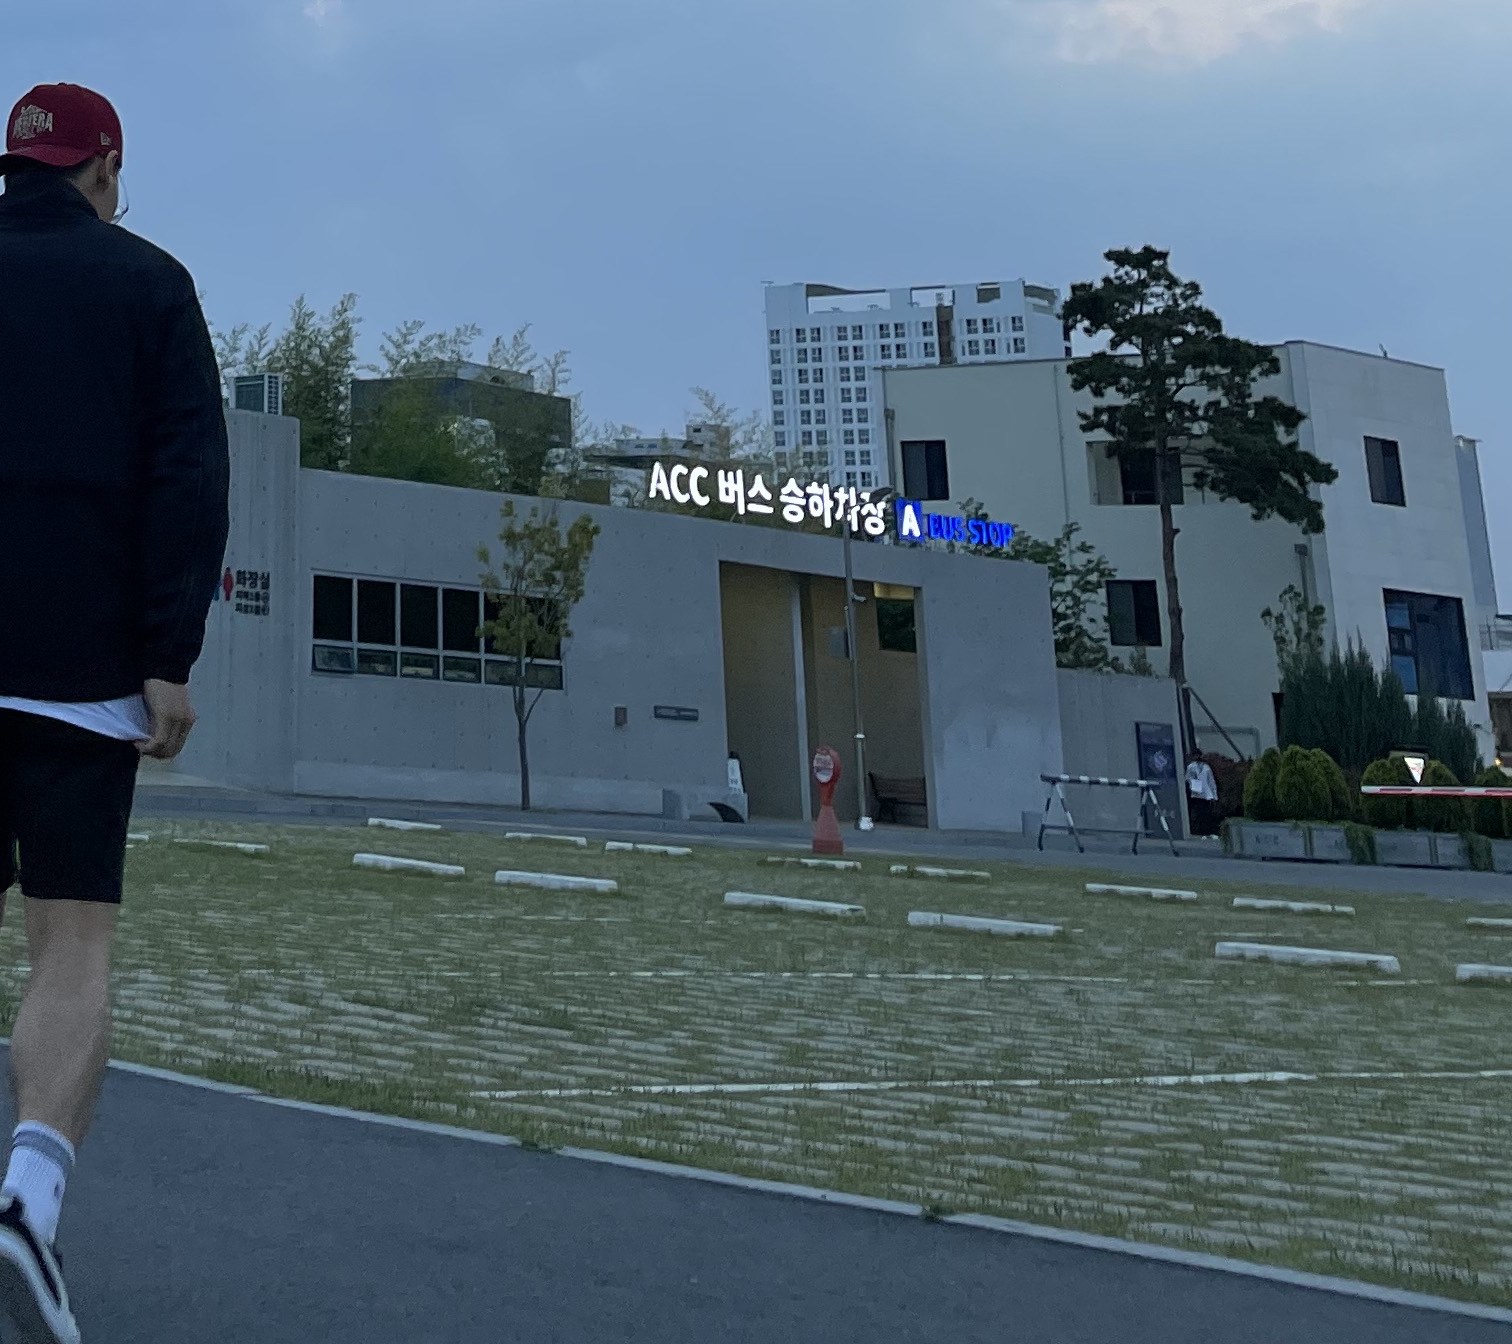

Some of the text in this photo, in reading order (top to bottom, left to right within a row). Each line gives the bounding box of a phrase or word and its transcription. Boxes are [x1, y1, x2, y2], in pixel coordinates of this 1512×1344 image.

[648, 461, 887, 536] ACC 버스 승하차장
[901, 504, 921, 538] A
[928, 512, 1014, 547] BUS STOP
[236, 570, 270, 590] 화장실
